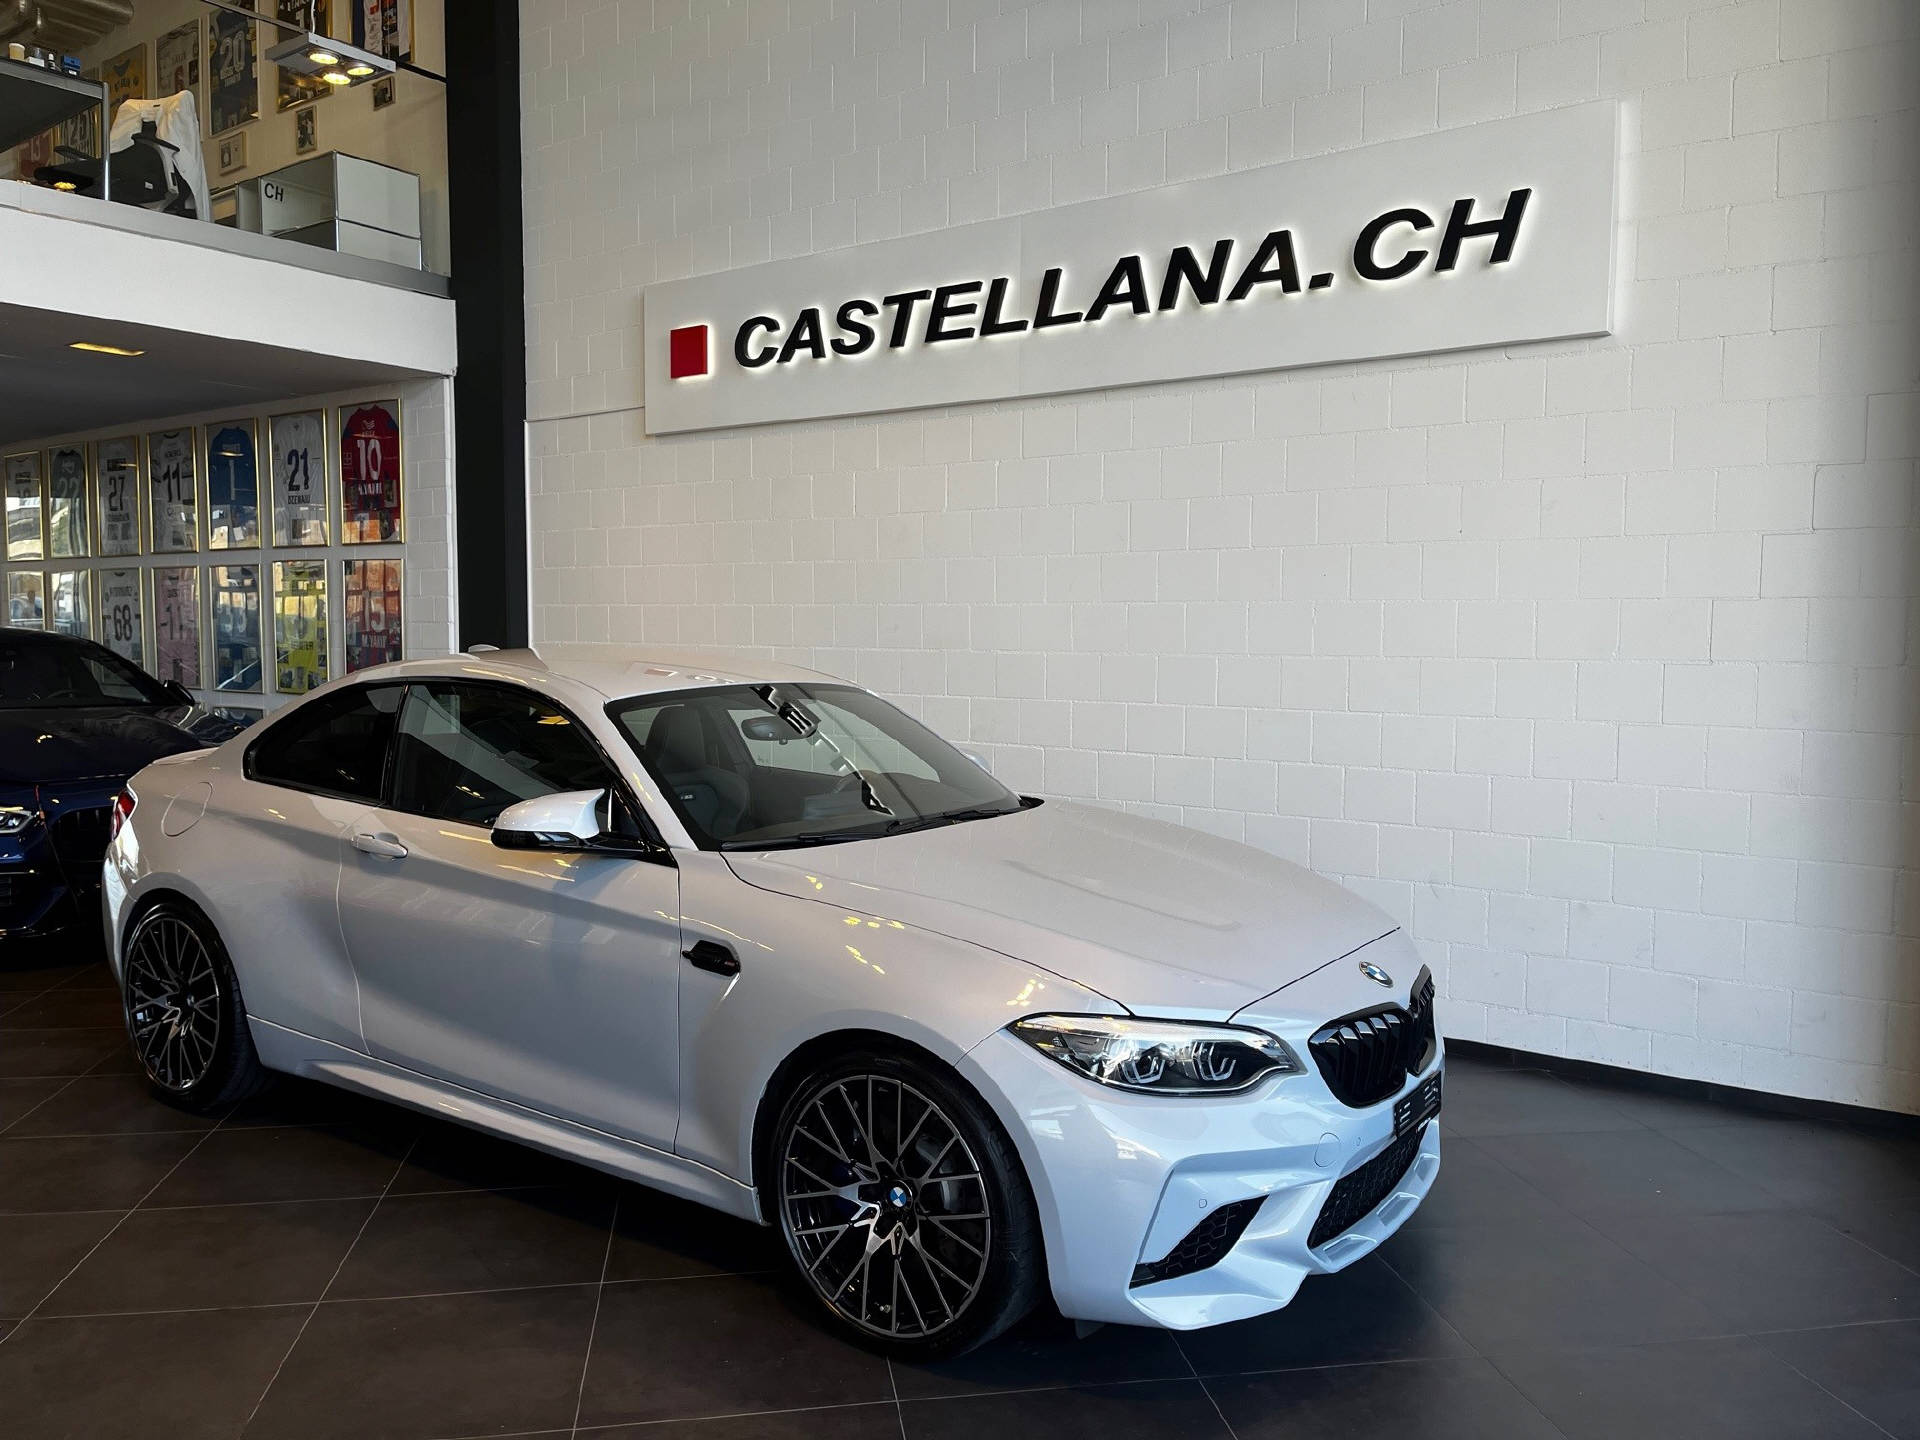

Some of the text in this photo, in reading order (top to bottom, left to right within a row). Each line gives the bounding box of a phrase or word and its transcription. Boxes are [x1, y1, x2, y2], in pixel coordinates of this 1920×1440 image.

[220, 30, 246, 80] 20
[264, 182, 284, 202] CH
[734, 188, 1531, 368] CASTELLANA.CH
[287, 447, 309, 491] 21
[356, 438, 382, 481] 10
[107, 474, 125, 512] 27
[162, 461, 181, 503] 11
[113, 604, 133, 641] 68
